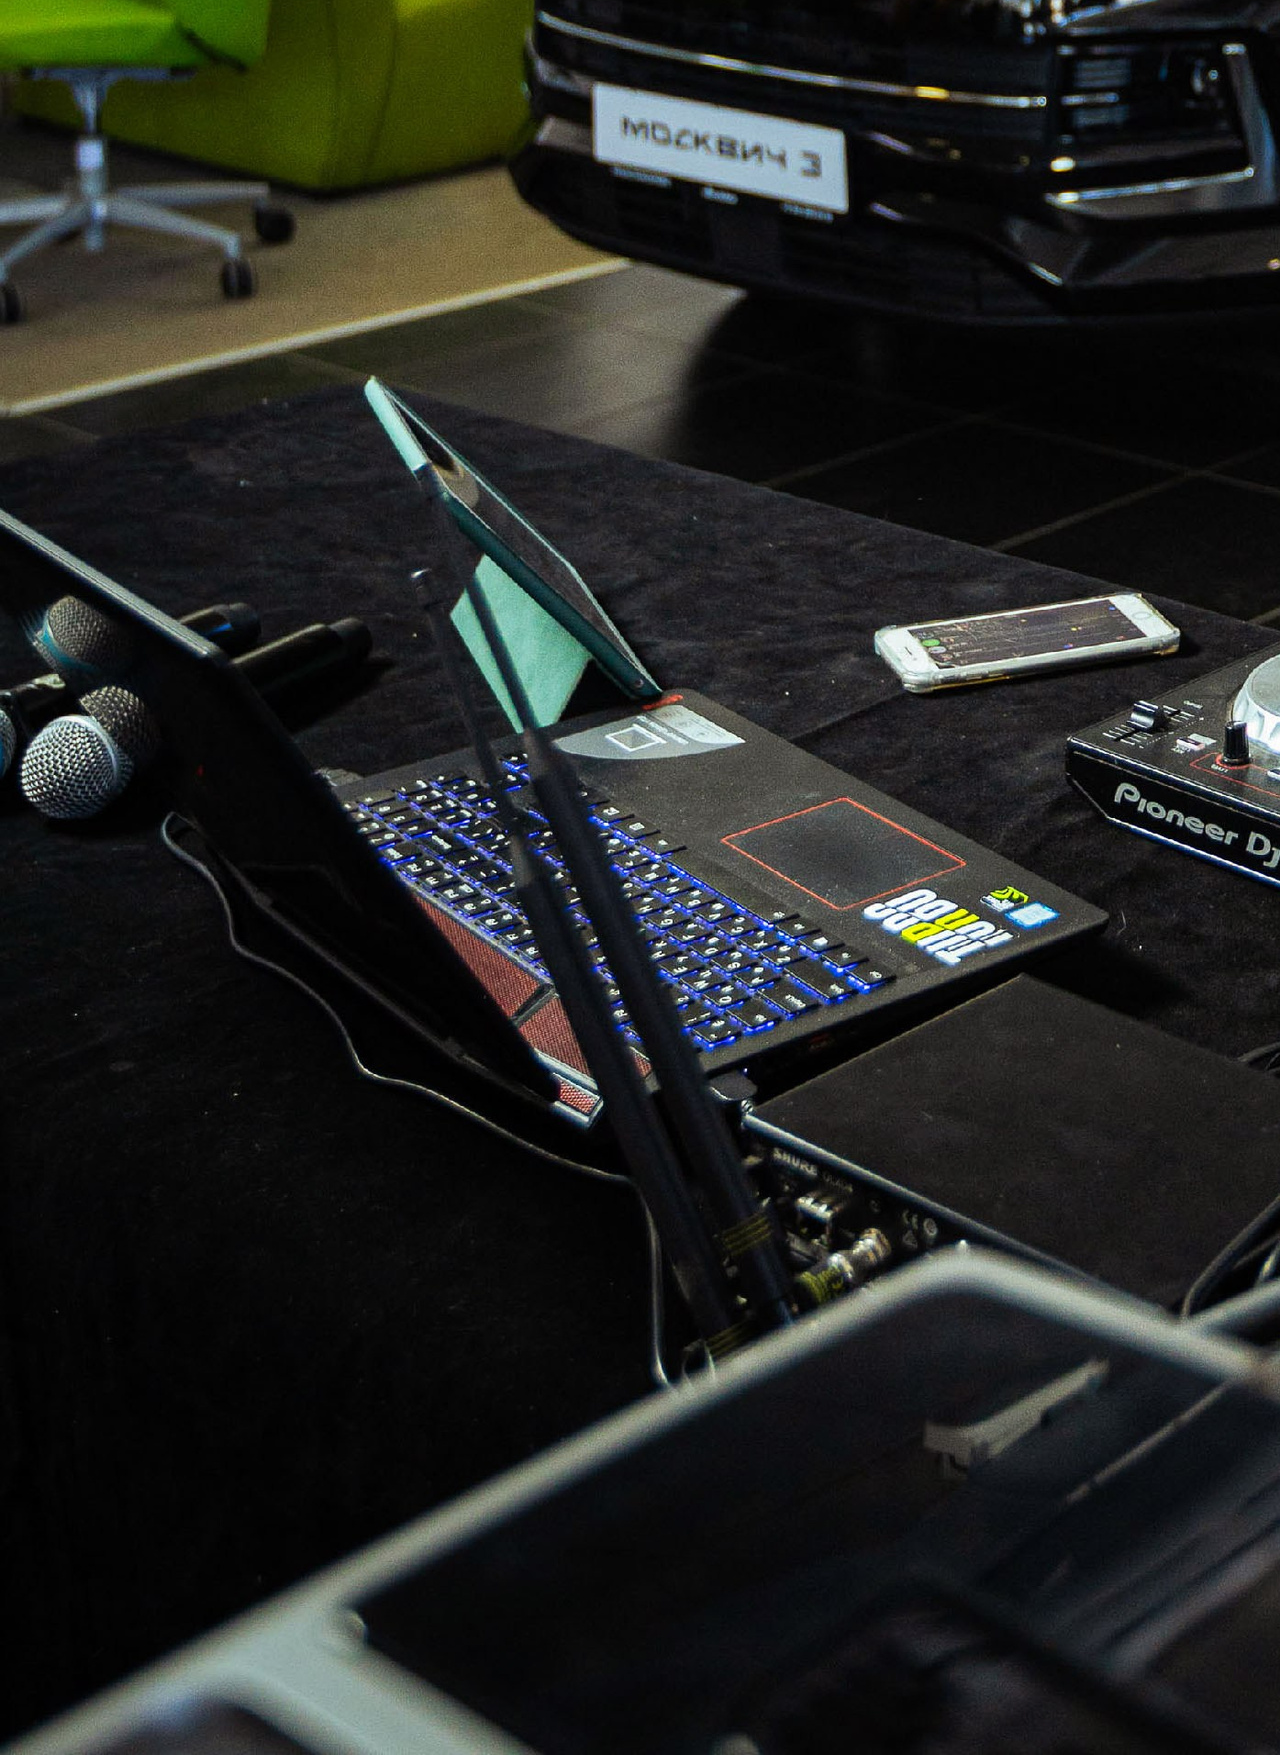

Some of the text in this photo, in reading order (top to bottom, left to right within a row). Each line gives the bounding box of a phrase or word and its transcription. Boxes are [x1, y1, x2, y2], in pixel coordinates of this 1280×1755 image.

[620, 114, 823, 178] МОСКВИЧ 3
[1113, 781, 1239, 848] Pioneer
[772, 1147, 818, 1177] SHURE
